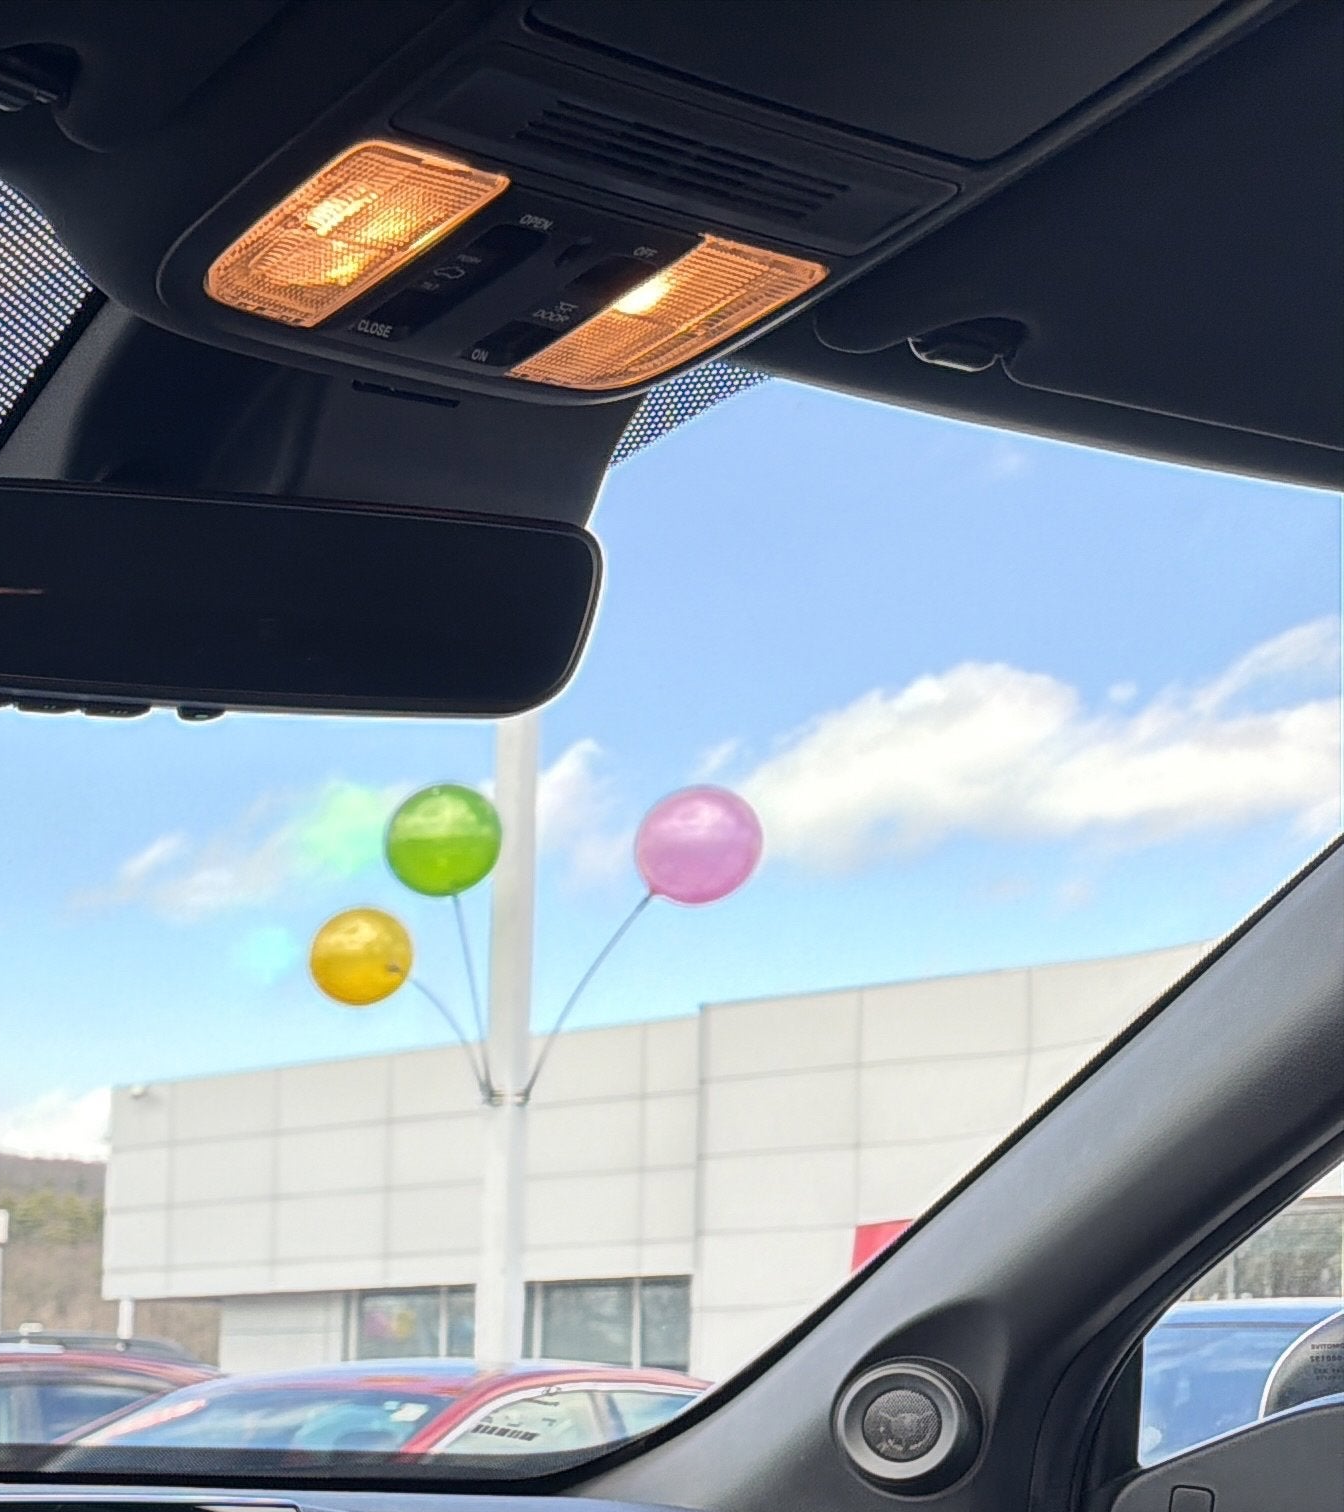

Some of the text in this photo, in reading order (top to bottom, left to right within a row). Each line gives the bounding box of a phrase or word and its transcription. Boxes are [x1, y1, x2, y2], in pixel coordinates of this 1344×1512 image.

[519, 214, 553, 231] OPEN
[633, 246, 658, 259] OFF
[532, 308, 570, 323] DOOR
[357, 319, 393, 338] CLOSE
[471, 349, 488, 363] ON
